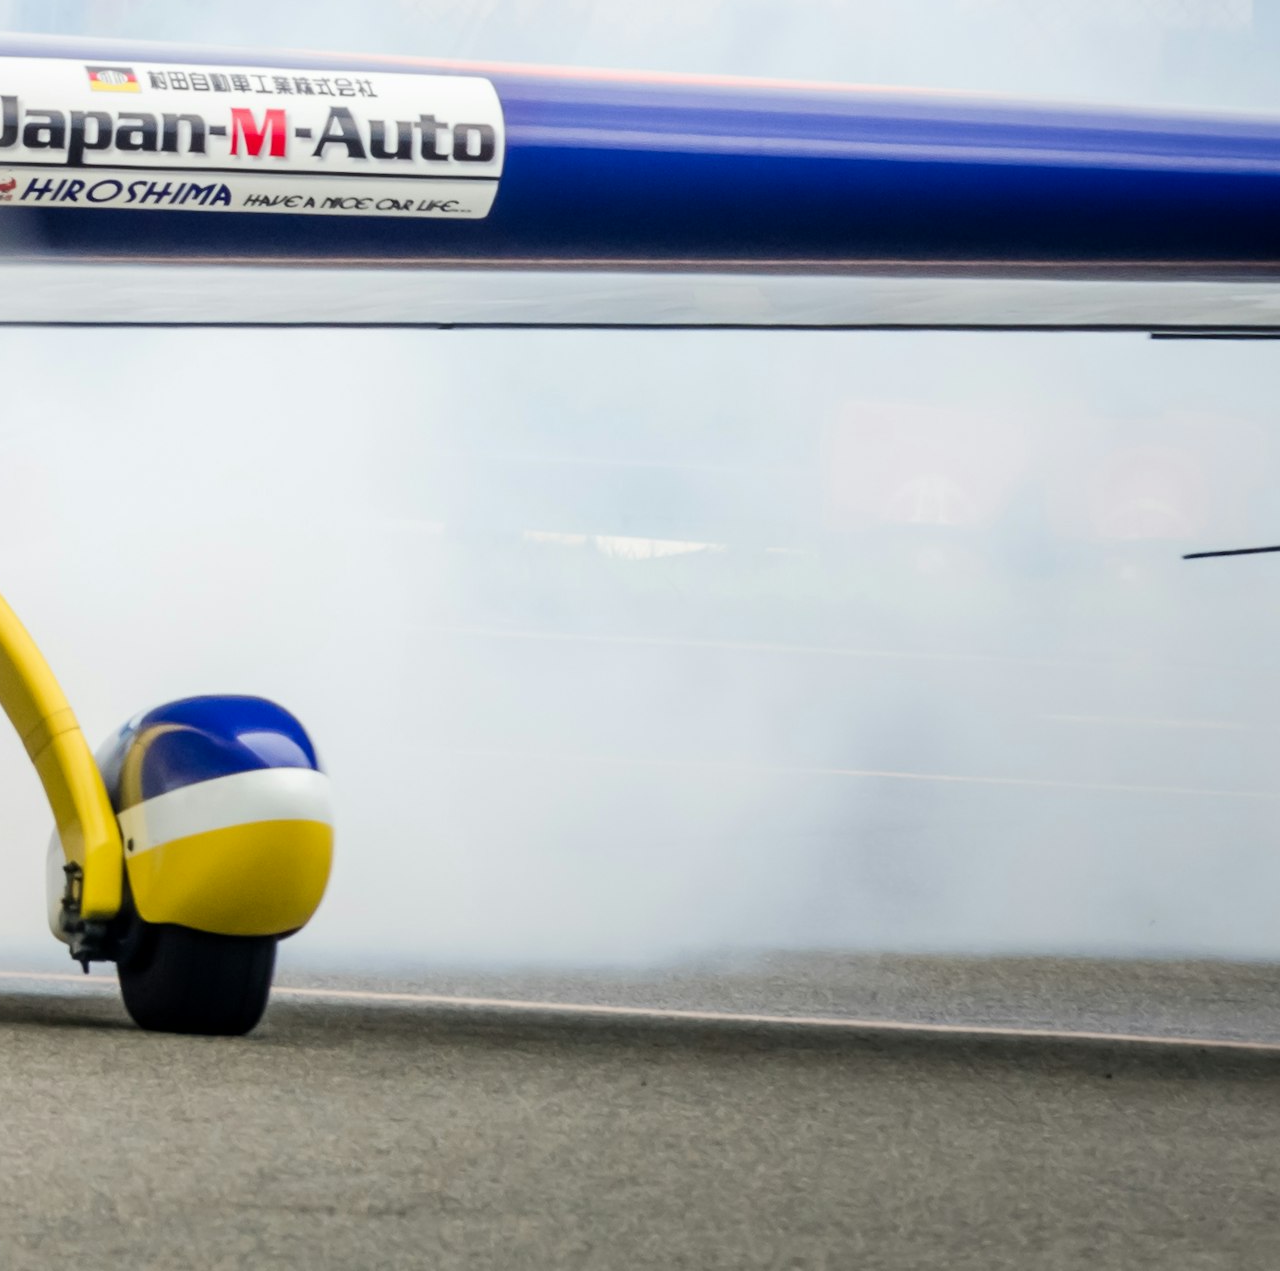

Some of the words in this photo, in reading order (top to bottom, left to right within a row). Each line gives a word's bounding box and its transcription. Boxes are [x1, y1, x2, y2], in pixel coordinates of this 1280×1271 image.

[146, 69, 379, 98] 村田自動車工業株式会社
[20, 178, 231, 206] HIROSHIMA
[243, 194, 303, 208] HAVE
[303, 196, 316, 209] A
[320, 196, 373, 211] NICE
[375, 198, 415, 212] CAR
